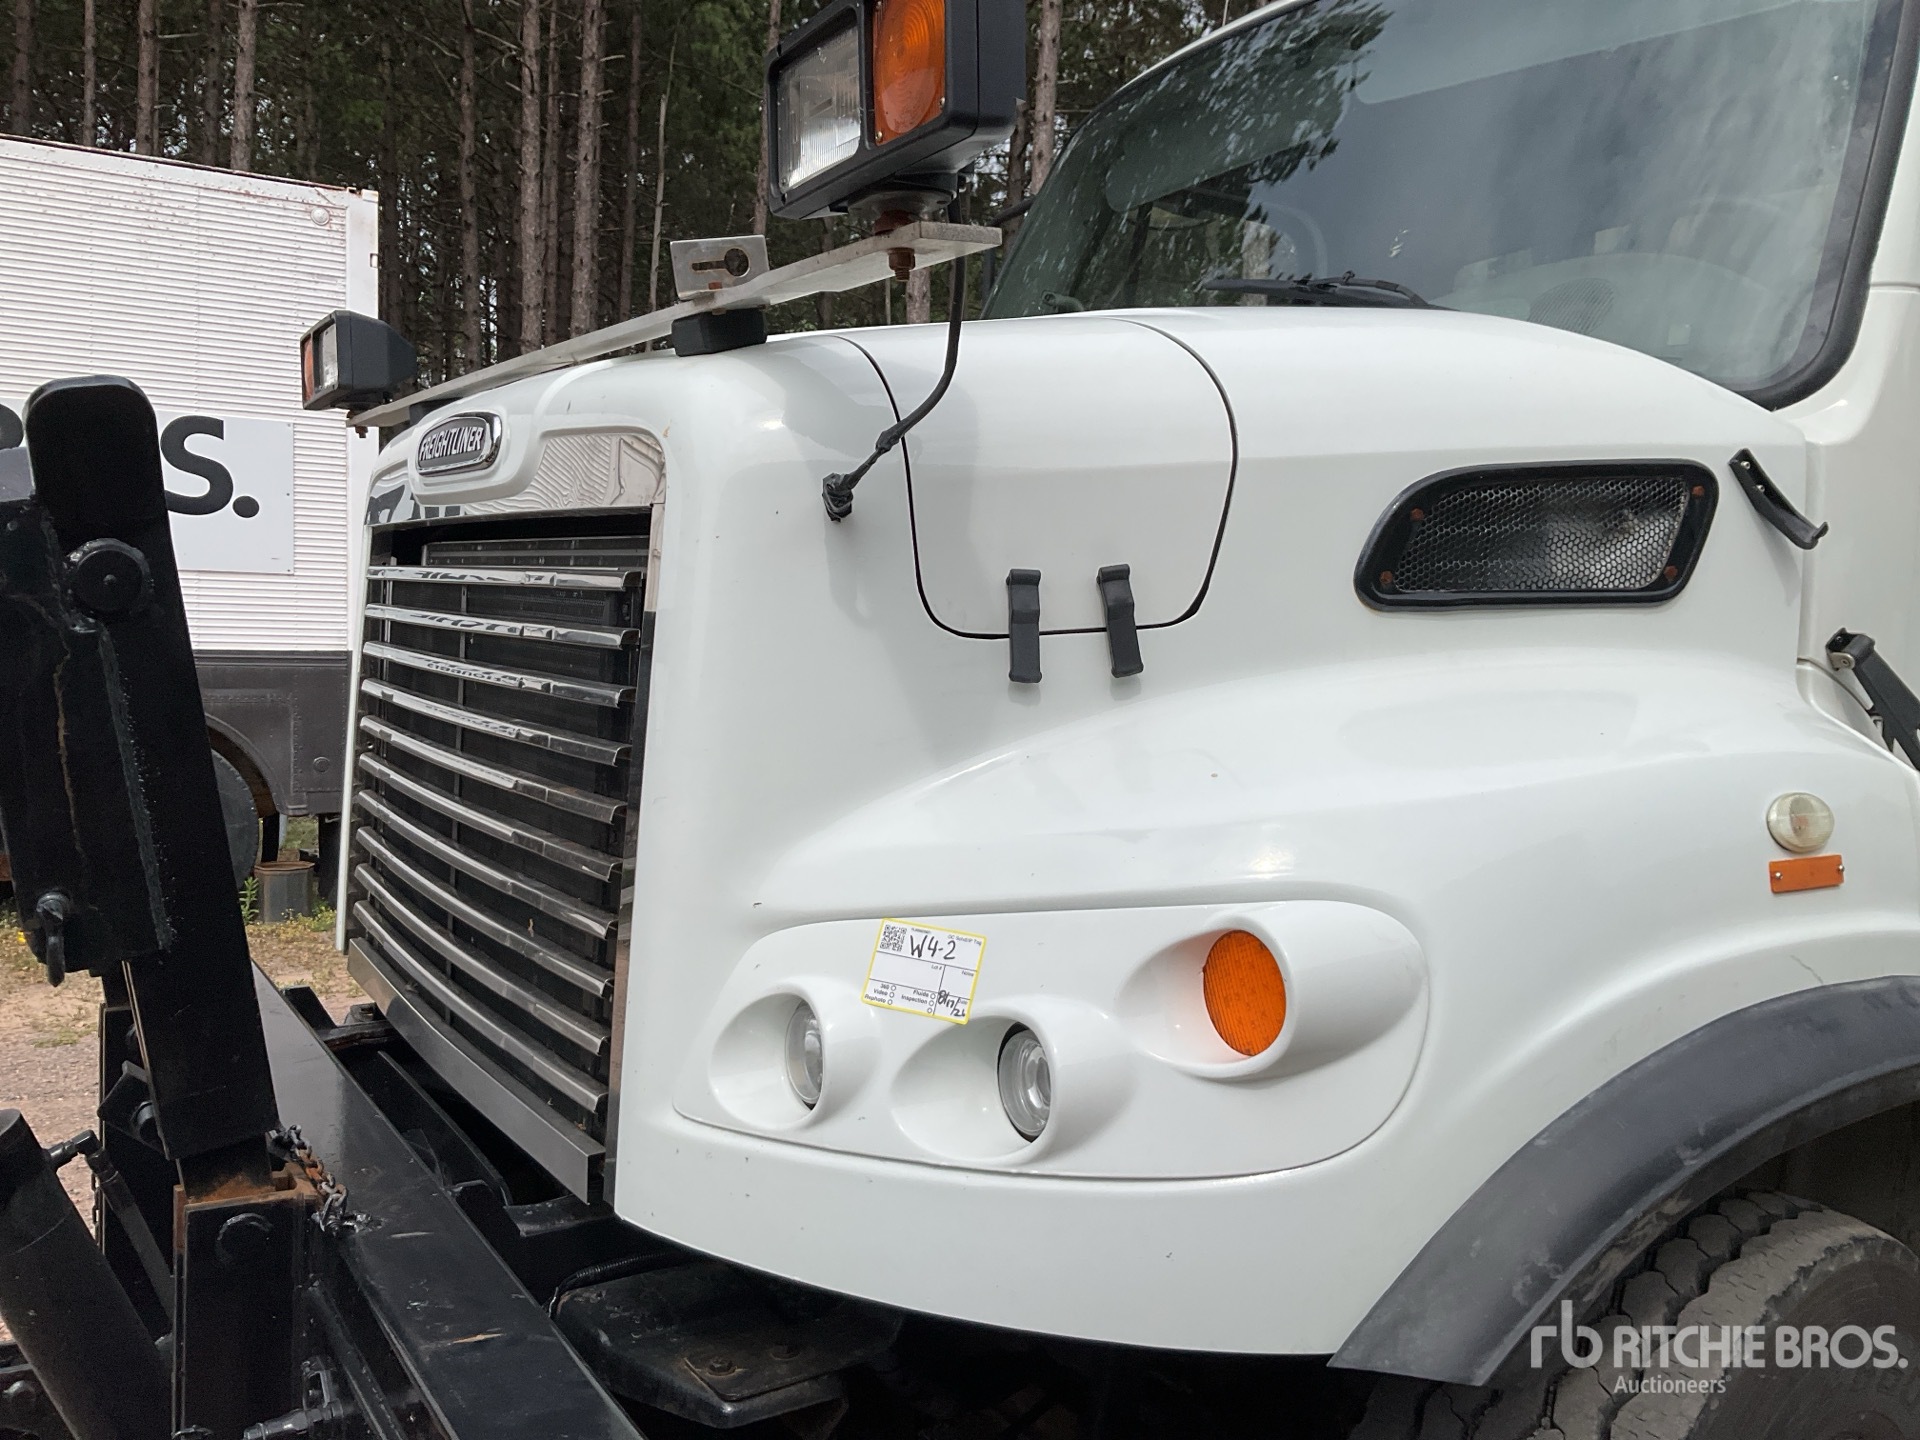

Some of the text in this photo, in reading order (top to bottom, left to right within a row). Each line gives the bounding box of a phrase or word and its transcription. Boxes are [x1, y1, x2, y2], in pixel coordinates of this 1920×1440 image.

[419, 426, 484, 462] FREIGHTLINER
[910, 934, 956, 961] W4-2
[873, 988, 888, 996] Video
[913, 989, 929, 998] Fluids
[901, 994, 928, 1005] Inspection
